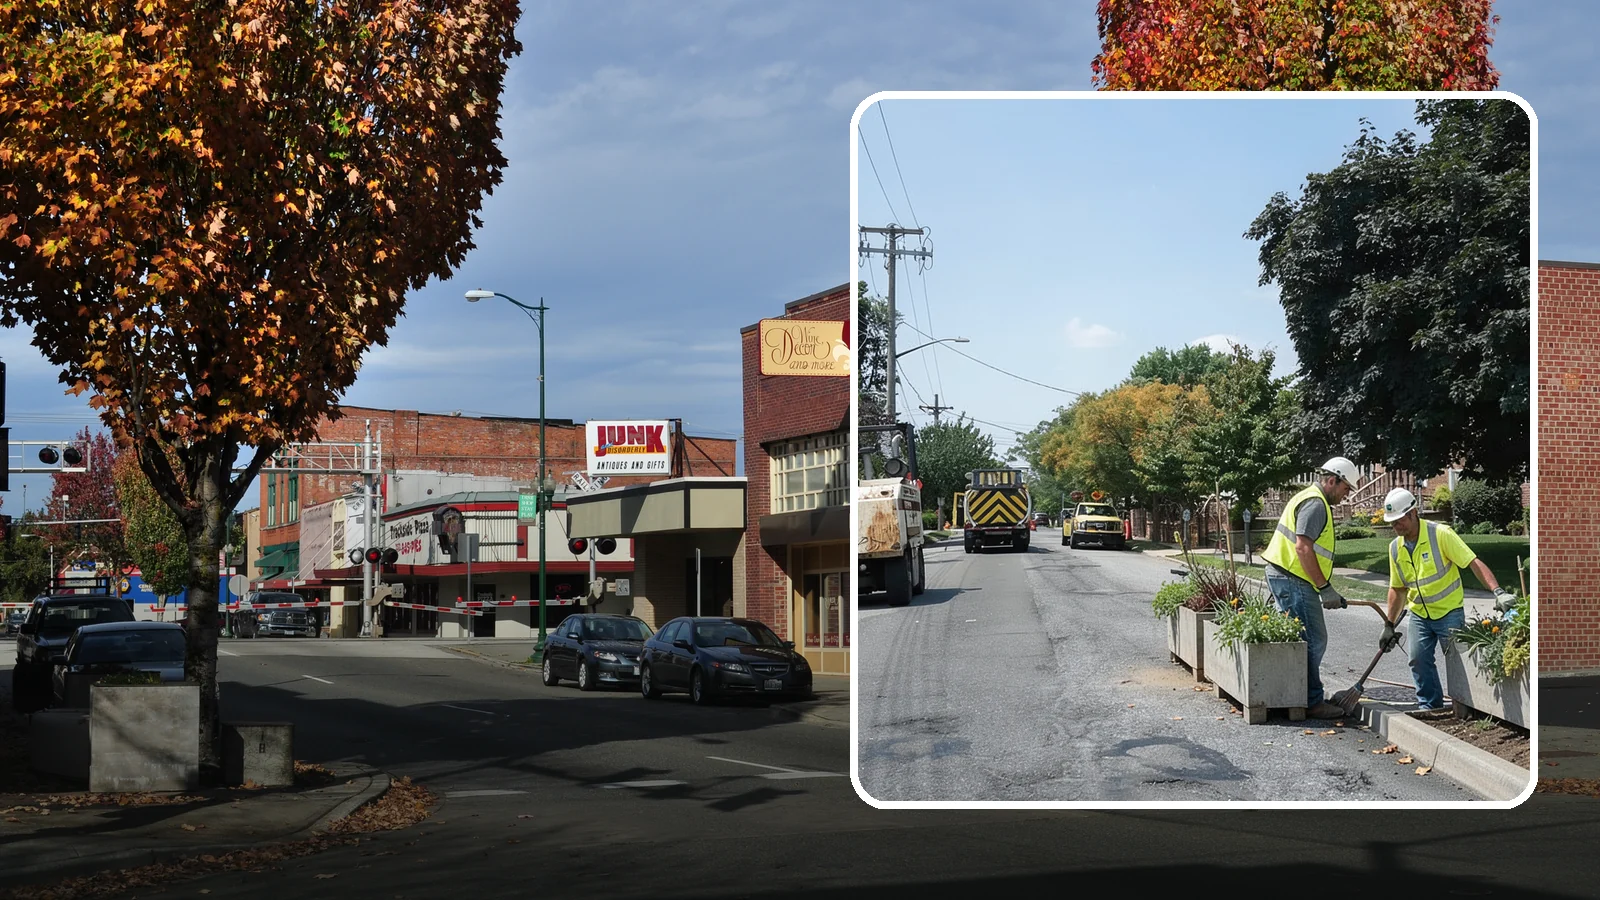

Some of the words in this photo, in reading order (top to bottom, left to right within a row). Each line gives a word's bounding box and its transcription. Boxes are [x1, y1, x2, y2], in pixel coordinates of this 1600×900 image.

[595, 425, 665, 457] JUNK
[607, 446, 645, 454] DISORDERLY
[597, 461, 627, 470] ANTIQUES
[631, 461, 643, 470] AND
[647, 461, 665, 469] GIFTS
[352, 498, 364, 510] CRO
[390, 522, 413, 539] Trackside
[414, 519, 429, 535] Pizza
